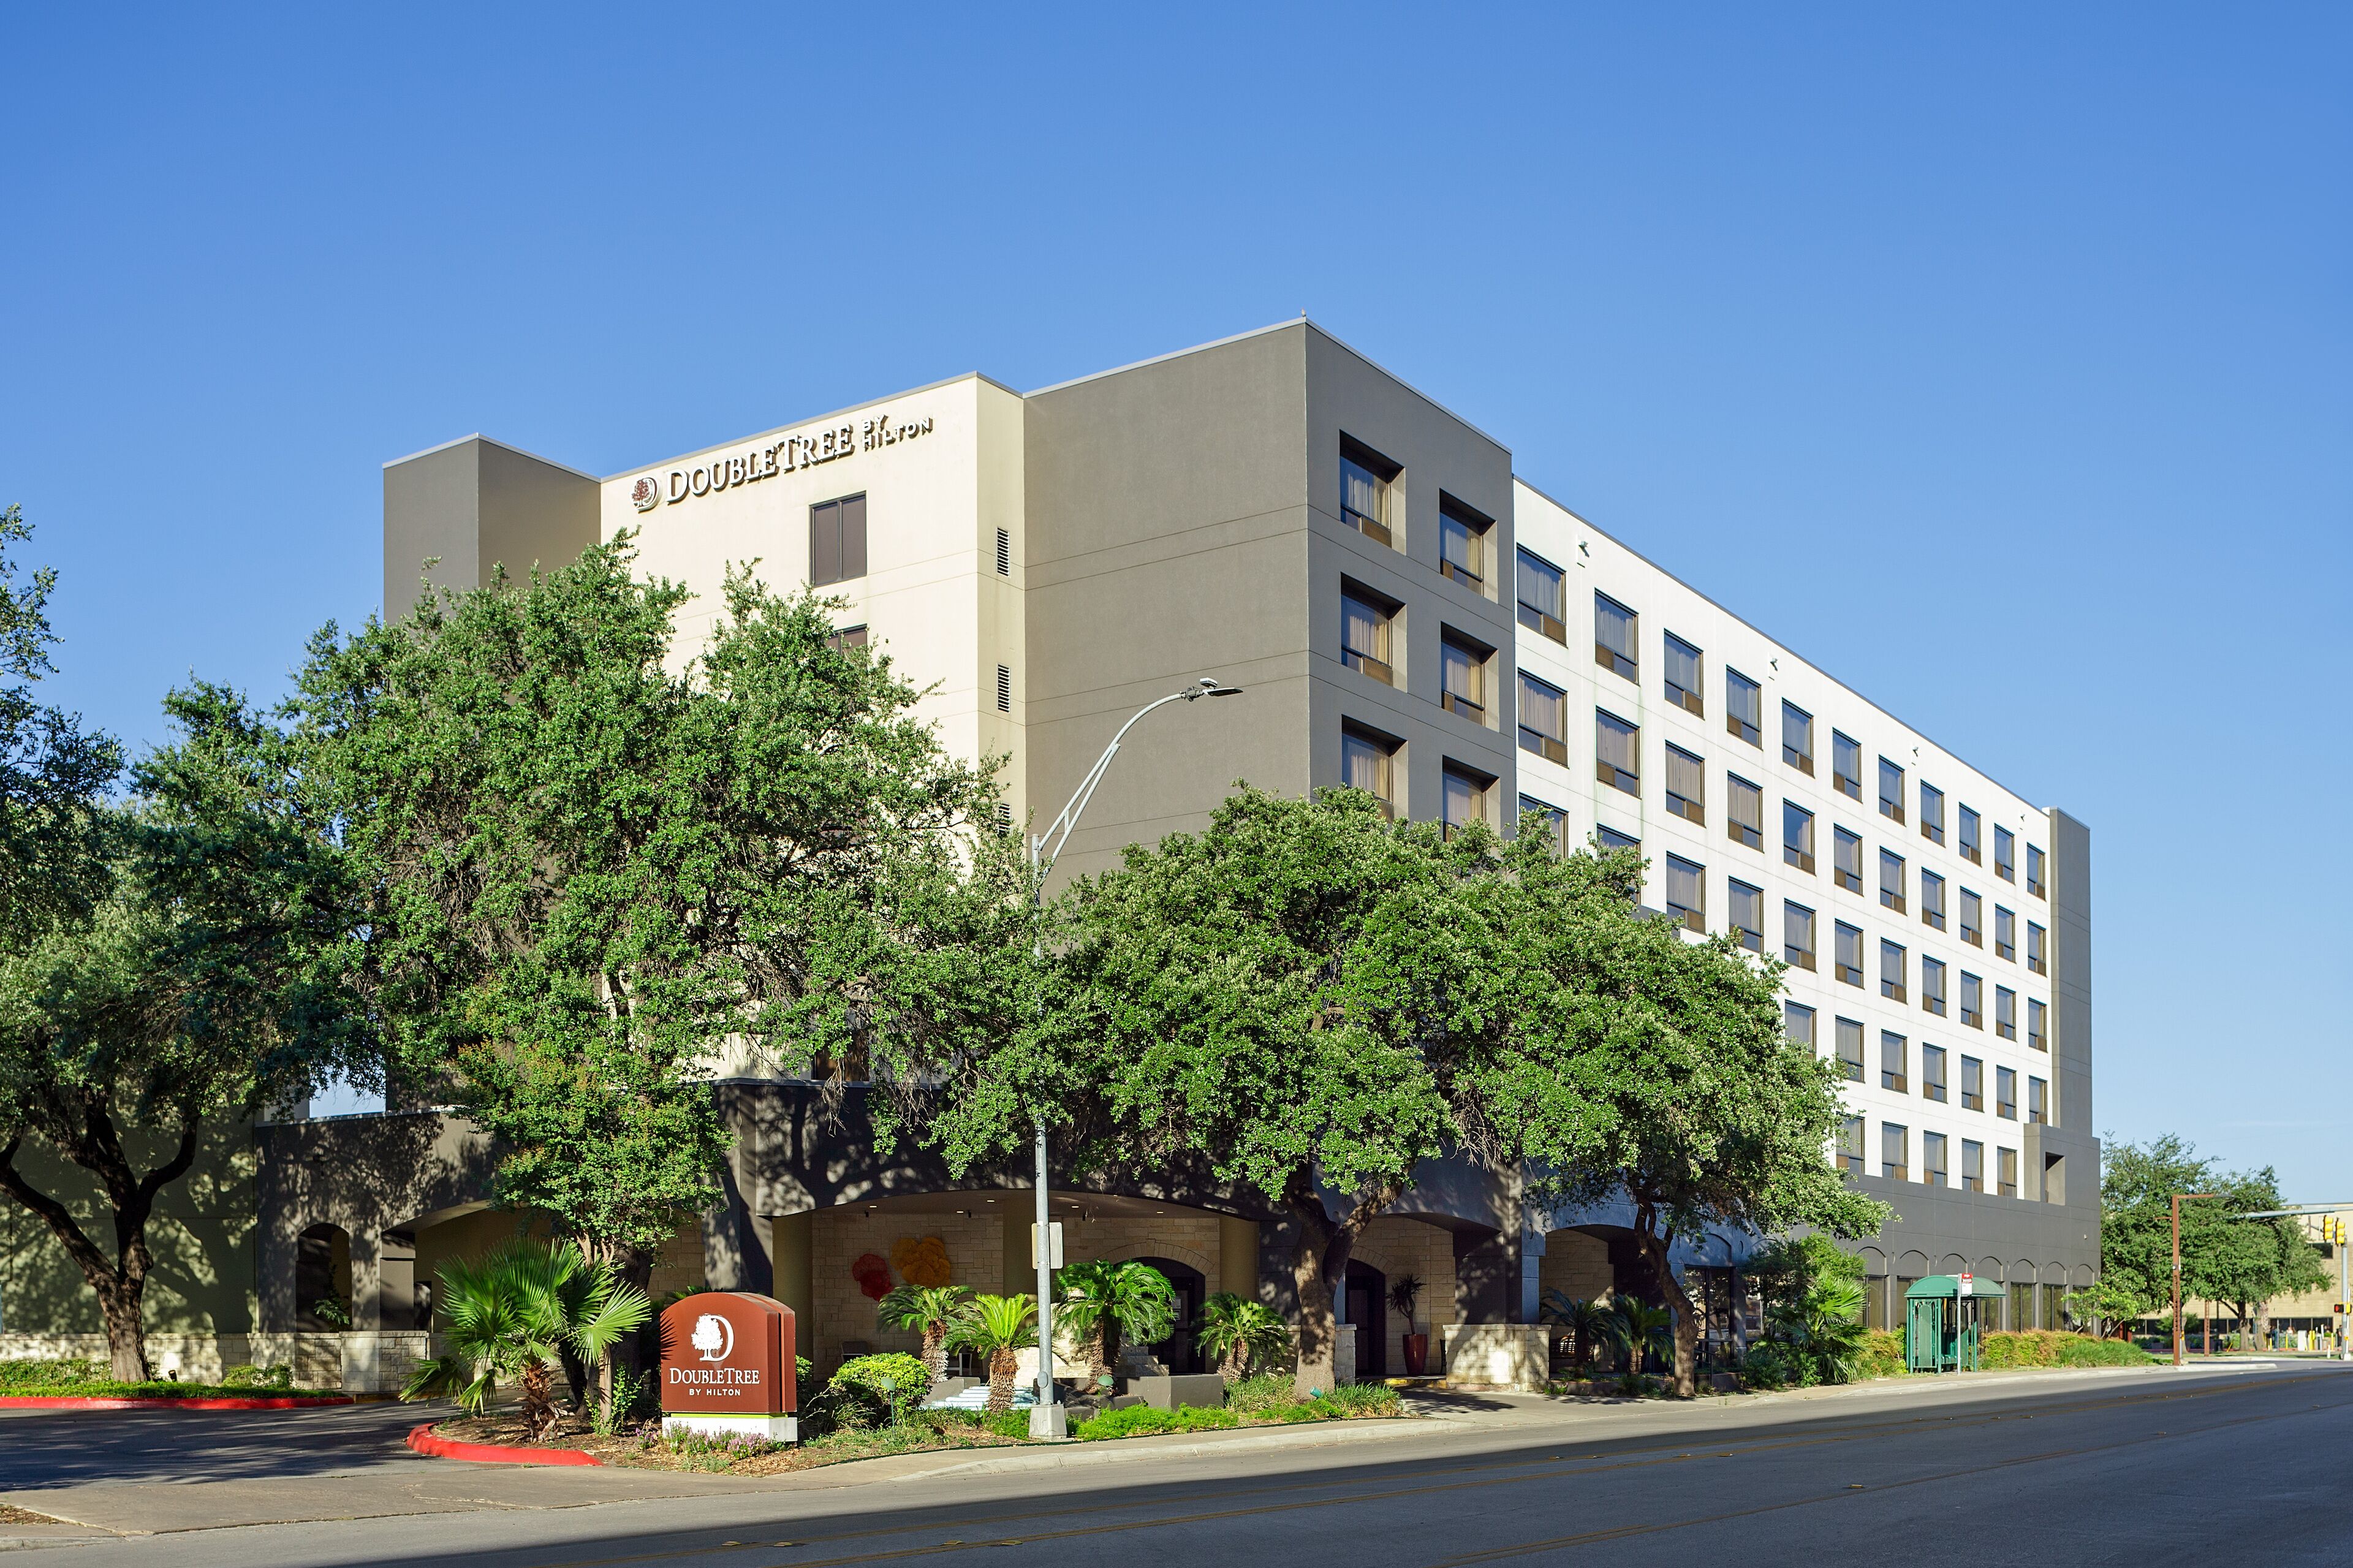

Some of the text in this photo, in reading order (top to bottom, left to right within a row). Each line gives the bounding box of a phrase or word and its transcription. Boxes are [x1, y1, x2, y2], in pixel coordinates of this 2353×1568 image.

[862, 414, 888, 433] BY
[862, 417, 933, 452] HILTON
[706, 1388, 741, 1396] HILTON
